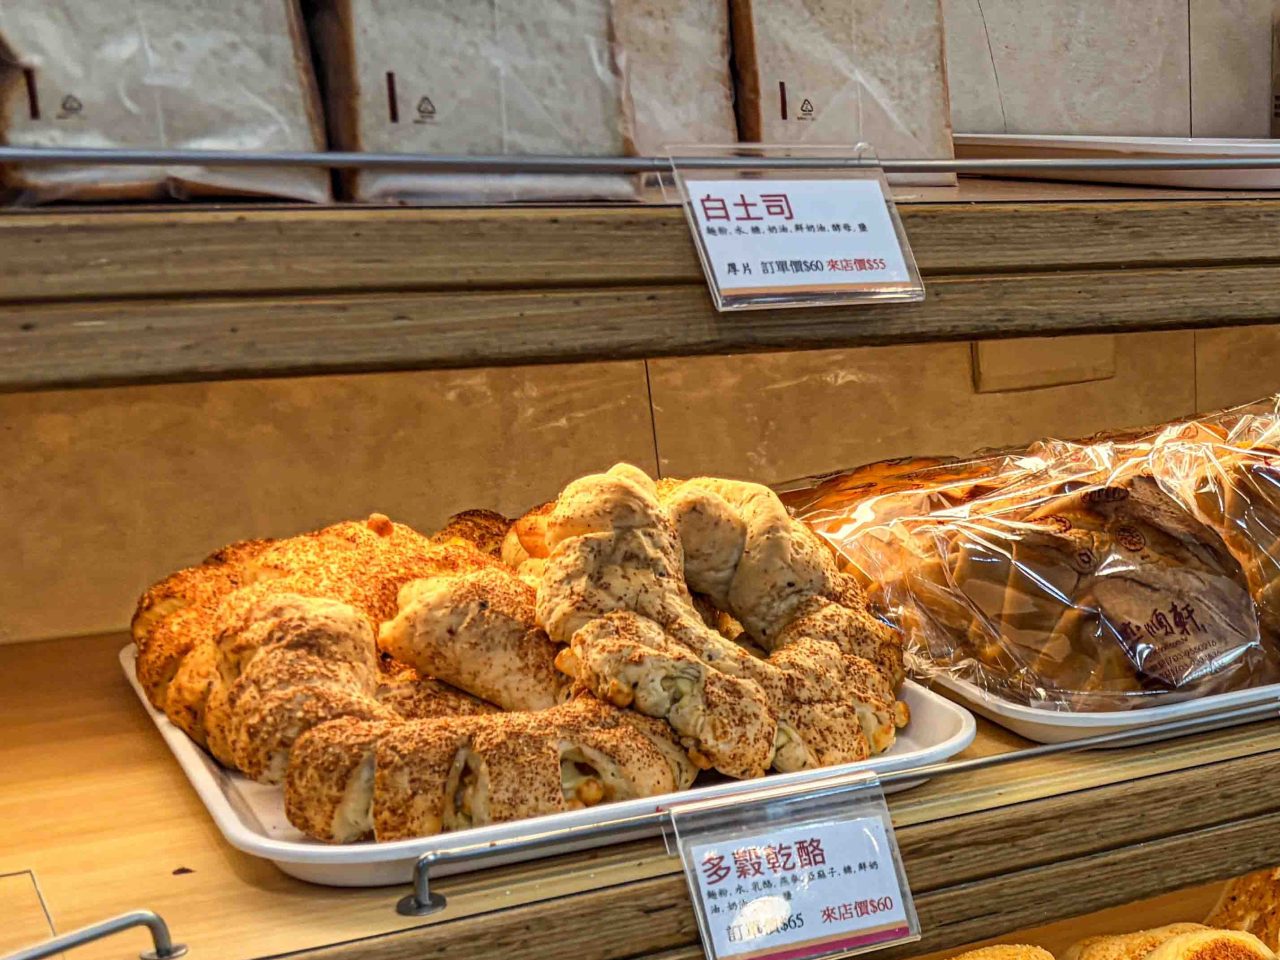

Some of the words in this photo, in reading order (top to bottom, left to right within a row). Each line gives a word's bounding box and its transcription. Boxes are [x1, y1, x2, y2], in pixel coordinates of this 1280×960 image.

[700, 194, 794, 222] 白土司
[760, 259, 824, 275] 訂單價$60
[826, 258, 887, 273] 來店價$55
[702, 838, 827, 886] 多穀乾酪
[821, 896, 894, 924] 來店價$60
